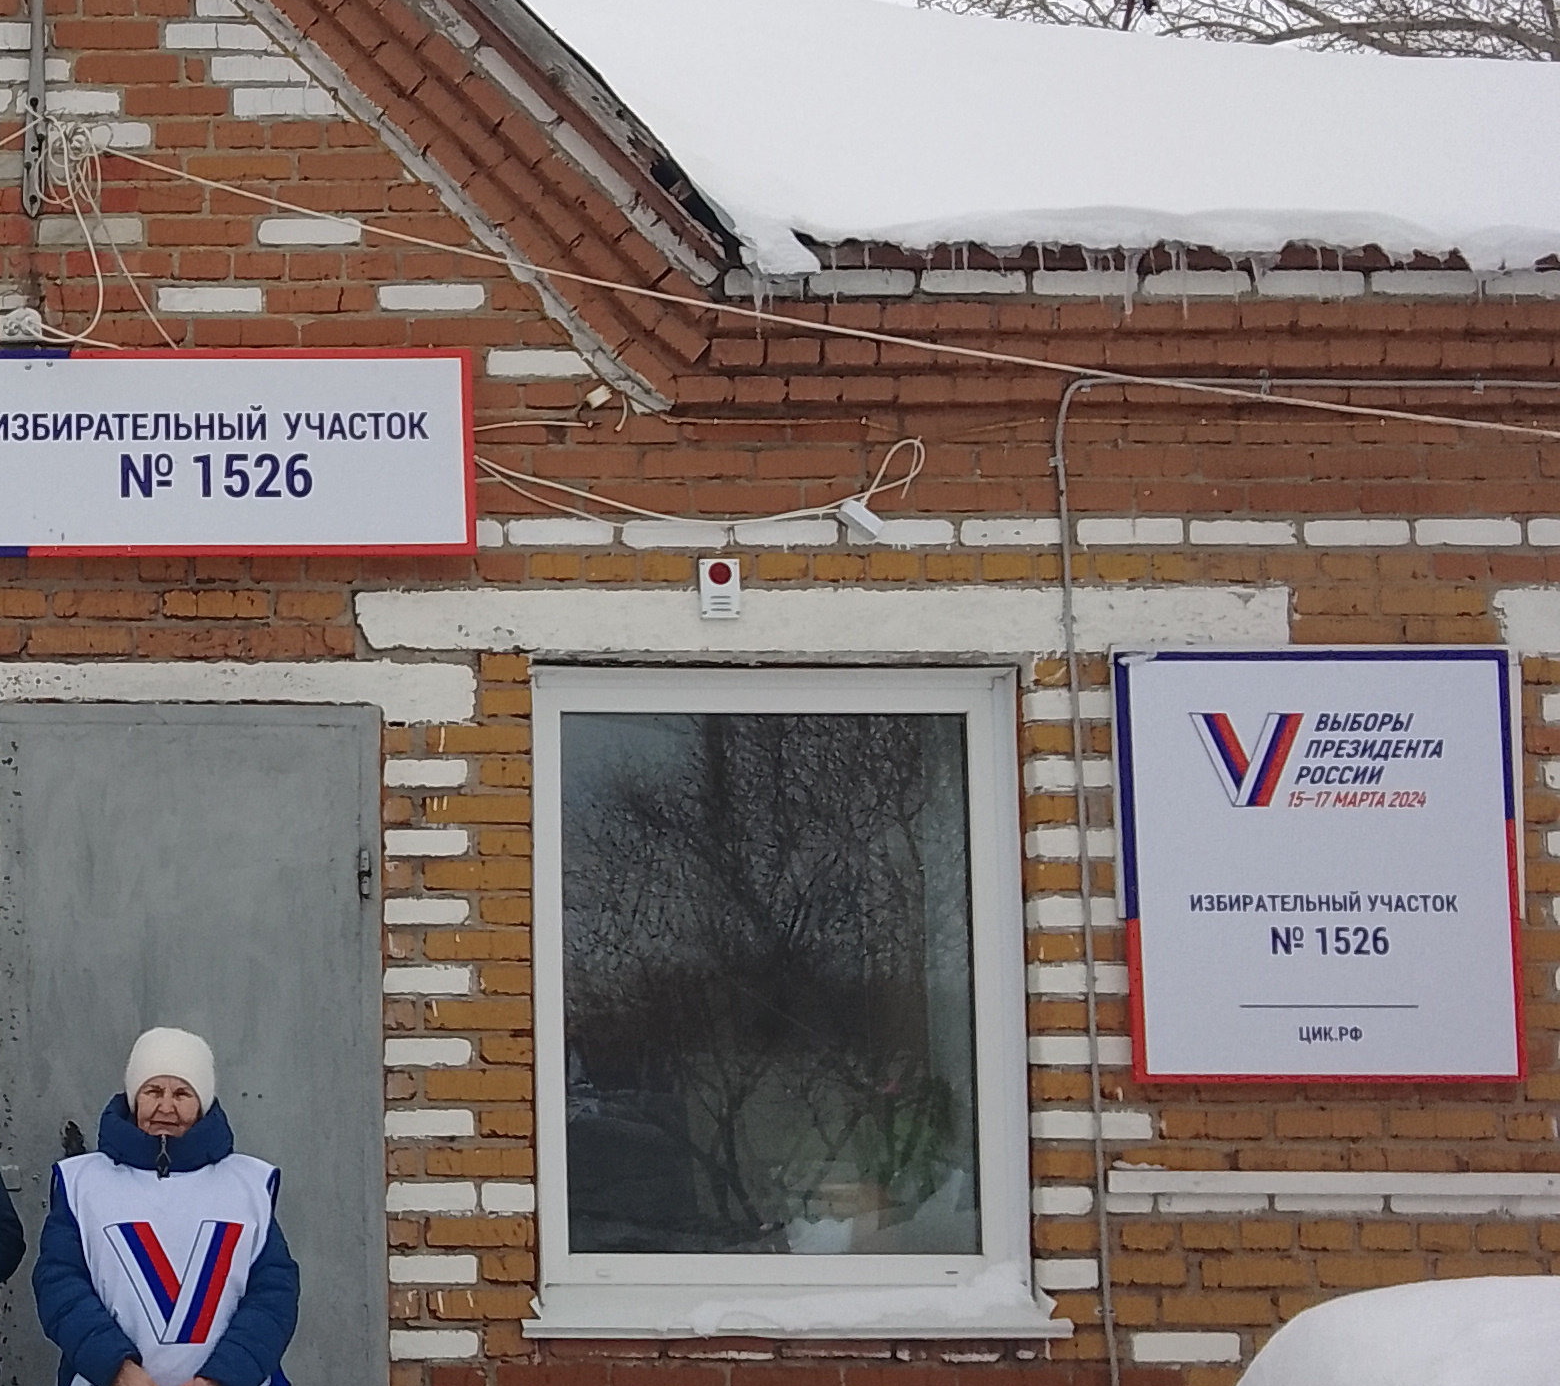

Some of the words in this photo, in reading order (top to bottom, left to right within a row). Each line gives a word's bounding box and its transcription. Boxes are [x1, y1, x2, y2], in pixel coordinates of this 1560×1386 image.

[283, 411, 430, 441] УЧАСТОК
[121, 454, 173, 498] №
[193, 454, 313, 499] 1526
[1314, 713, 1415, 732] ВЫБОРЫ
[1304, 739, 1444, 761] ПРЕЗИДЕНТА
[1294, 766, 1385, 785] РОССИИ
[1332, 791, 1387, 808] МАРТА
[1387, 791, 1427, 808] 2024
[1190, 891, 1361, 913] ИЗБИРАТЕЛЬНЫЙ
[1368, 894, 1459, 913] УЧАСТОК
[1271, 927, 1304, 955] №
[1316, 927, 1390, 955] 1526
[1299, 1026, 1363, 1044] ЦИК.РФ
